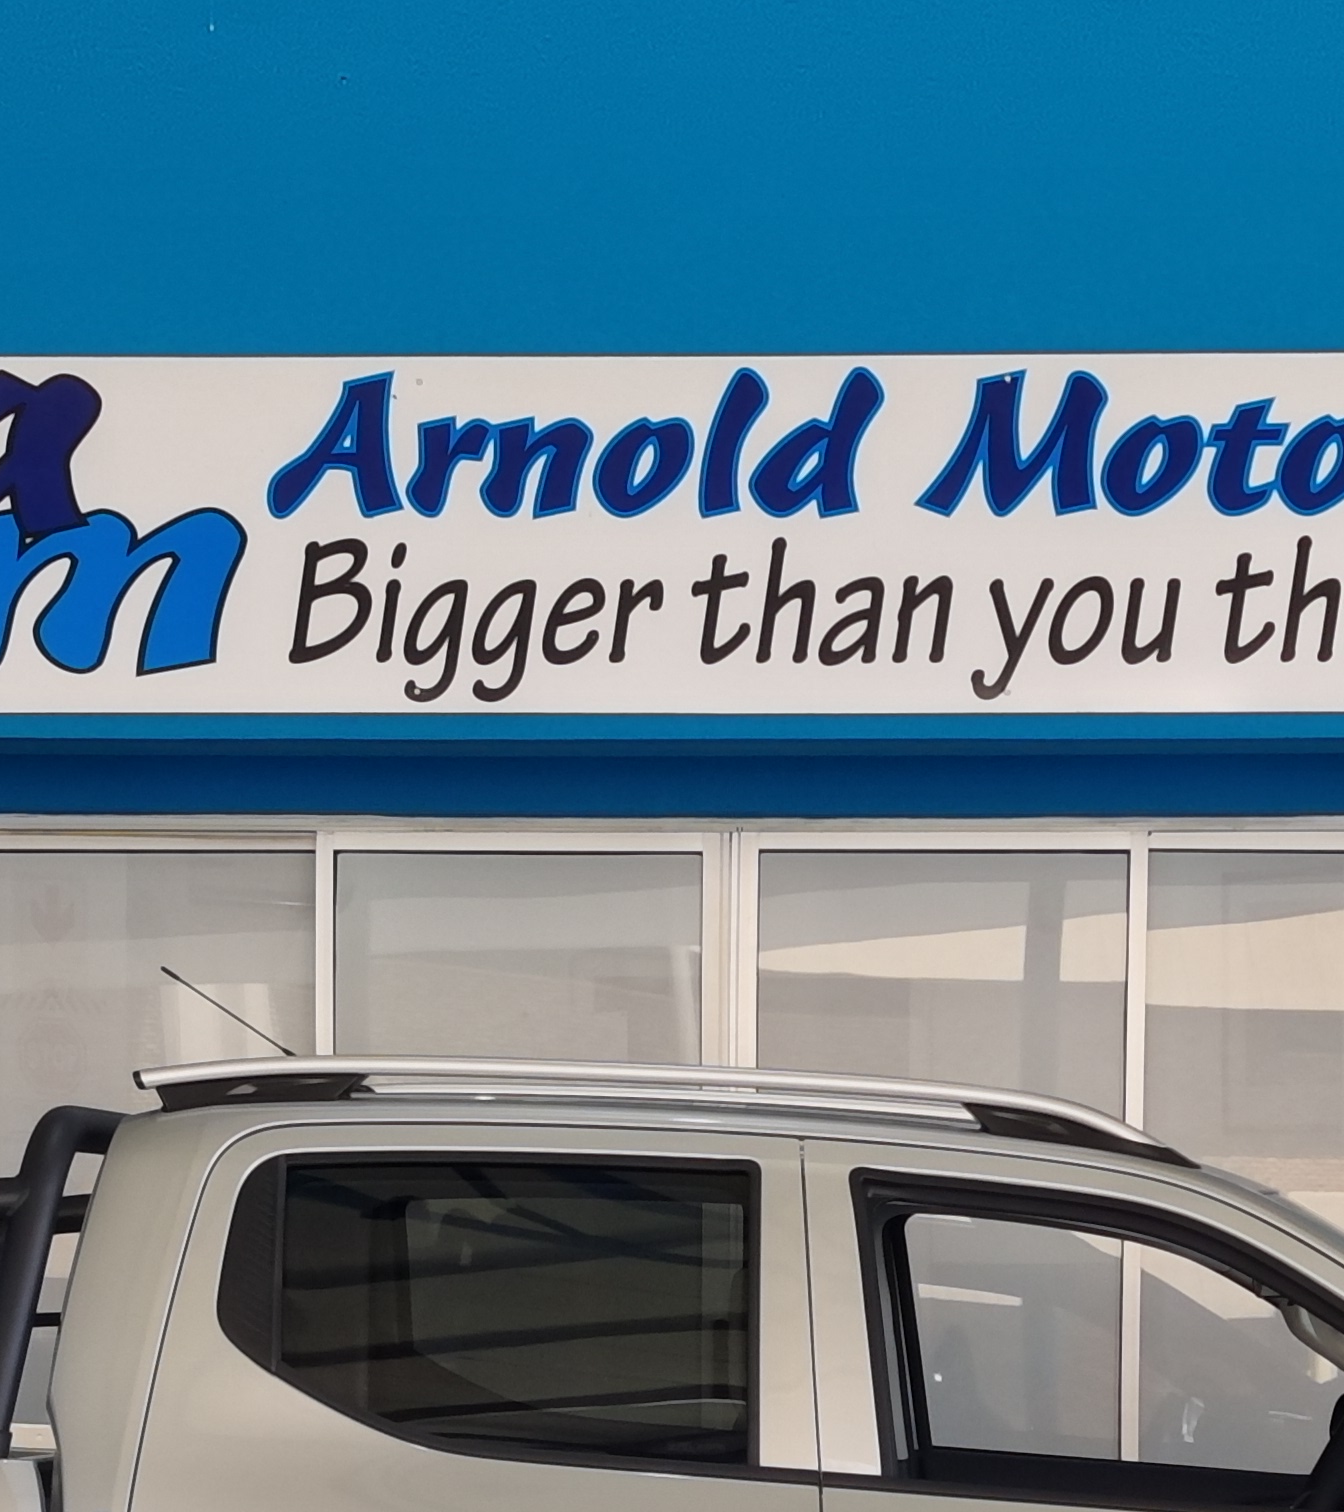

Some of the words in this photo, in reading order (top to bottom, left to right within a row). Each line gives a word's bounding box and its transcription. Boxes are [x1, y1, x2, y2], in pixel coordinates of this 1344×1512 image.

[267, 366, 885, 520] Arnold
[288, 537, 664, 702] Bigger
[690, 536, 954, 667] than
[971, 570, 1182, 702] you
